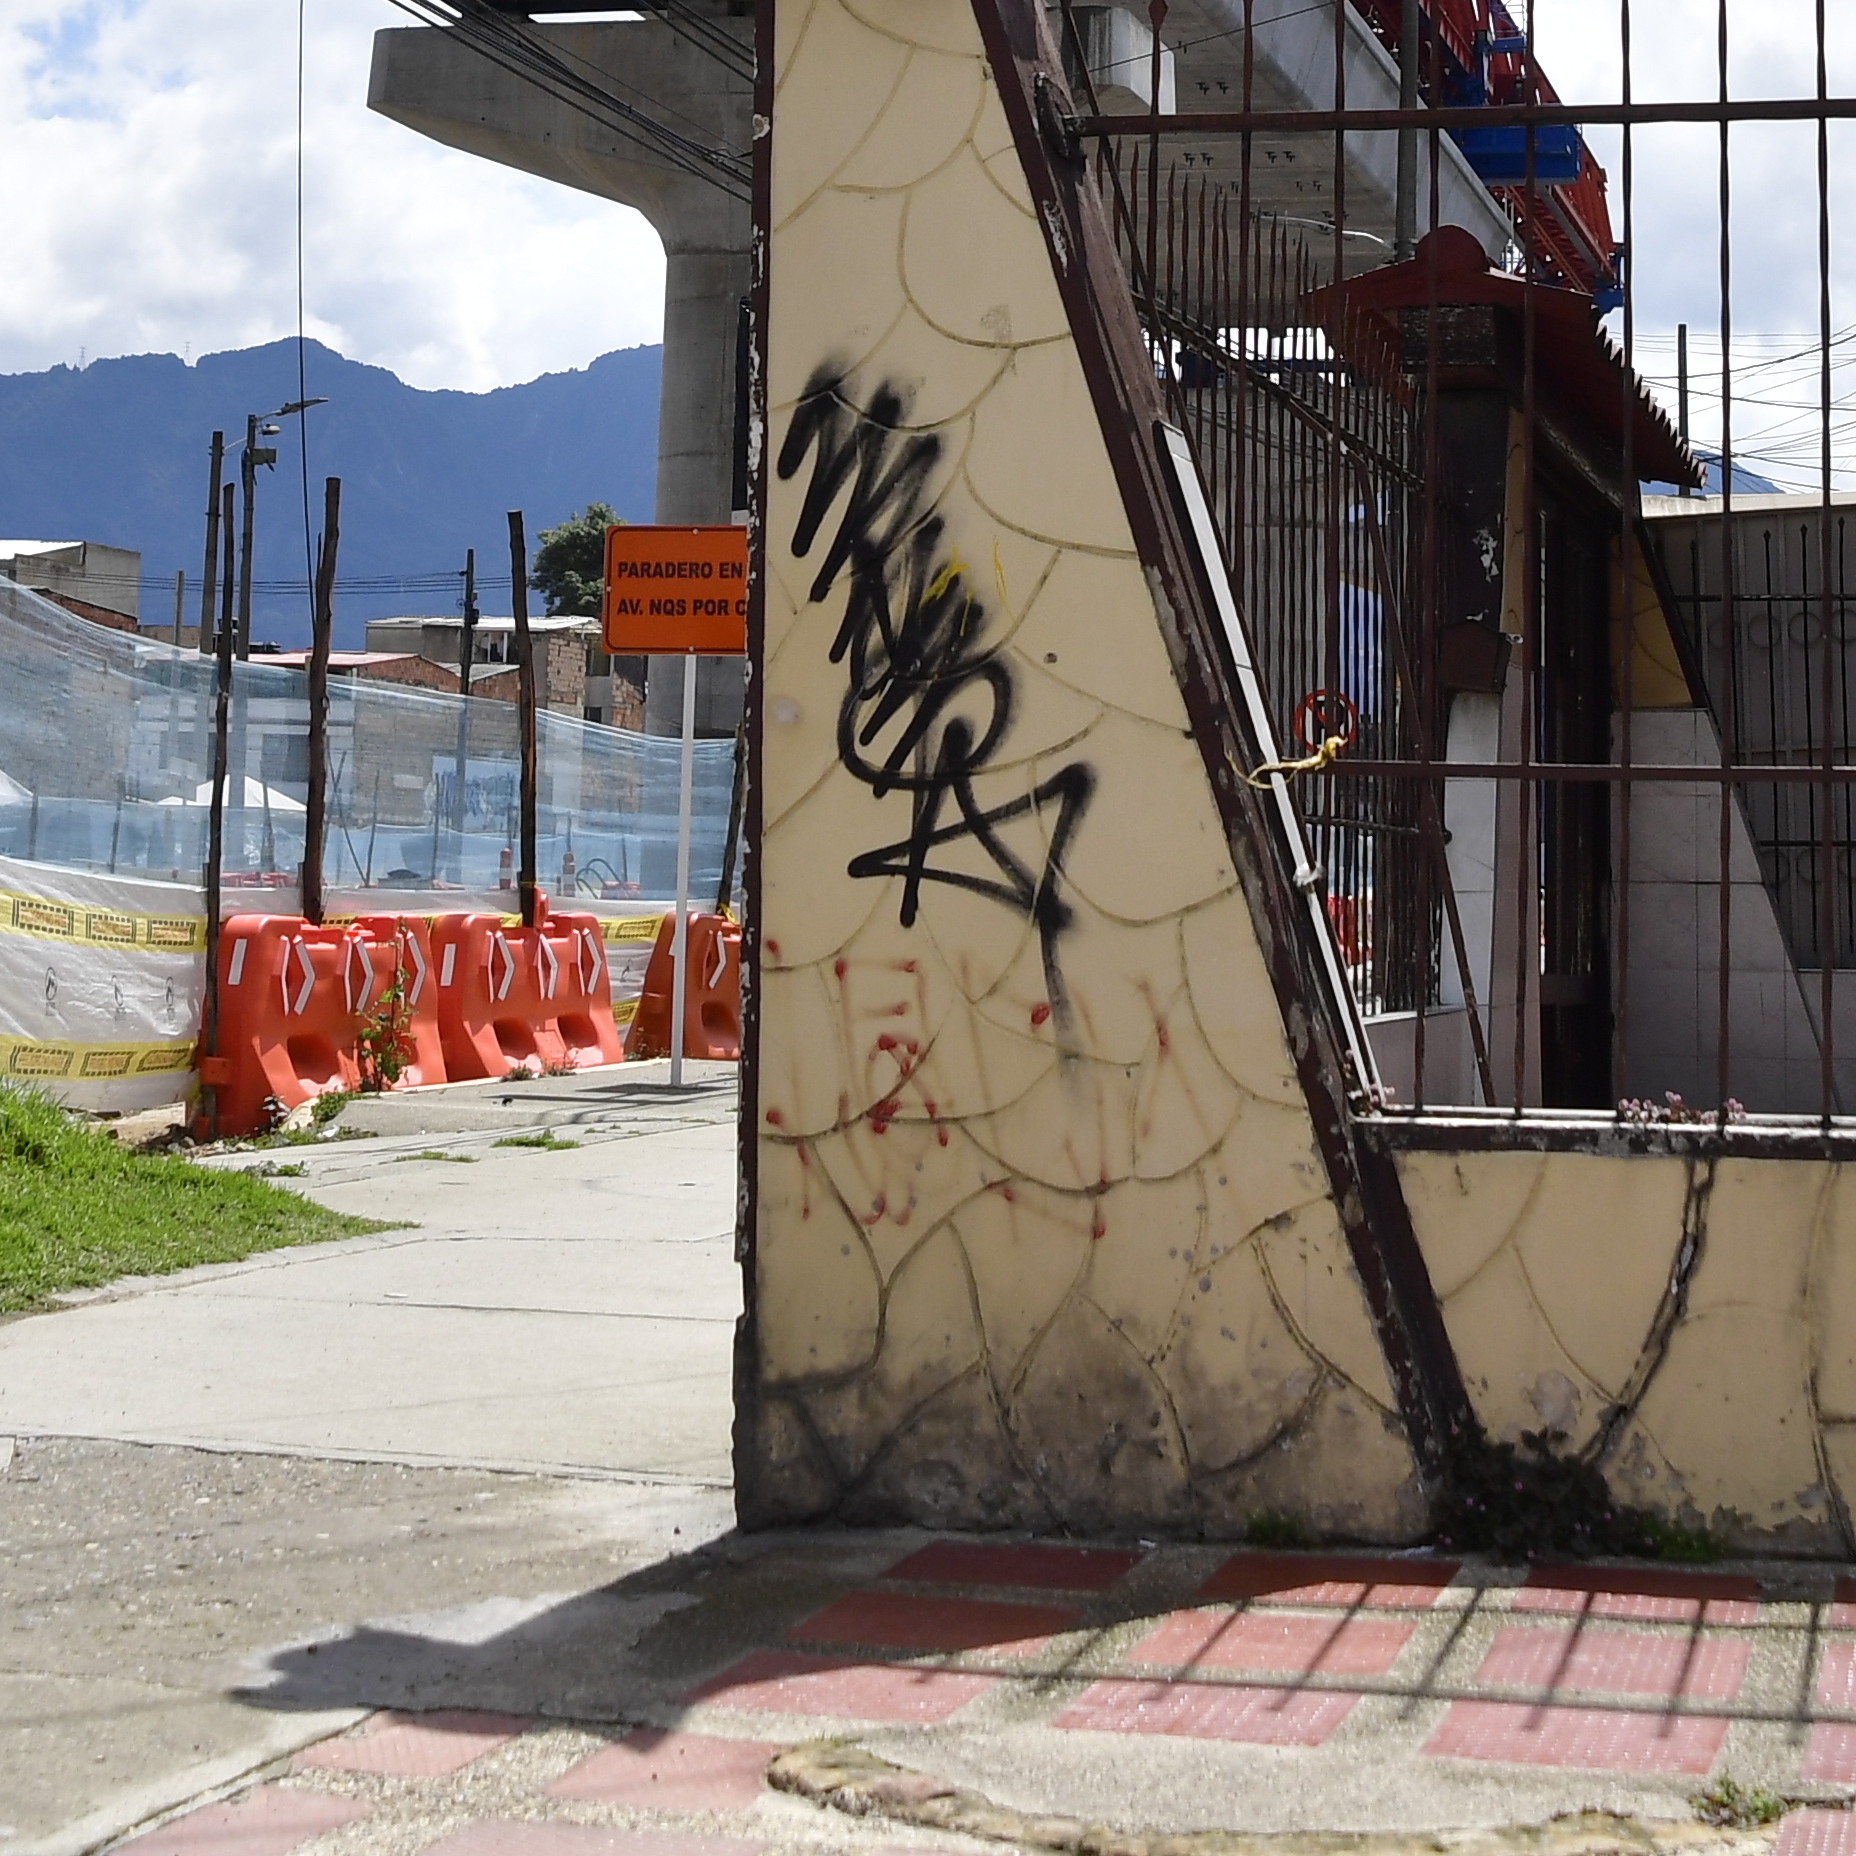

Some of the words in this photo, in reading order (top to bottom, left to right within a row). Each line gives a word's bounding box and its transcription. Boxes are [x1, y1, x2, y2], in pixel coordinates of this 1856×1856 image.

[617, 561, 713, 579] PARADERO
[719, 561, 743, 579] EN
[617, 598, 643, 616] AV.
[649, 598, 687, 616] NQS
[692, 598, 729, 616] POR
